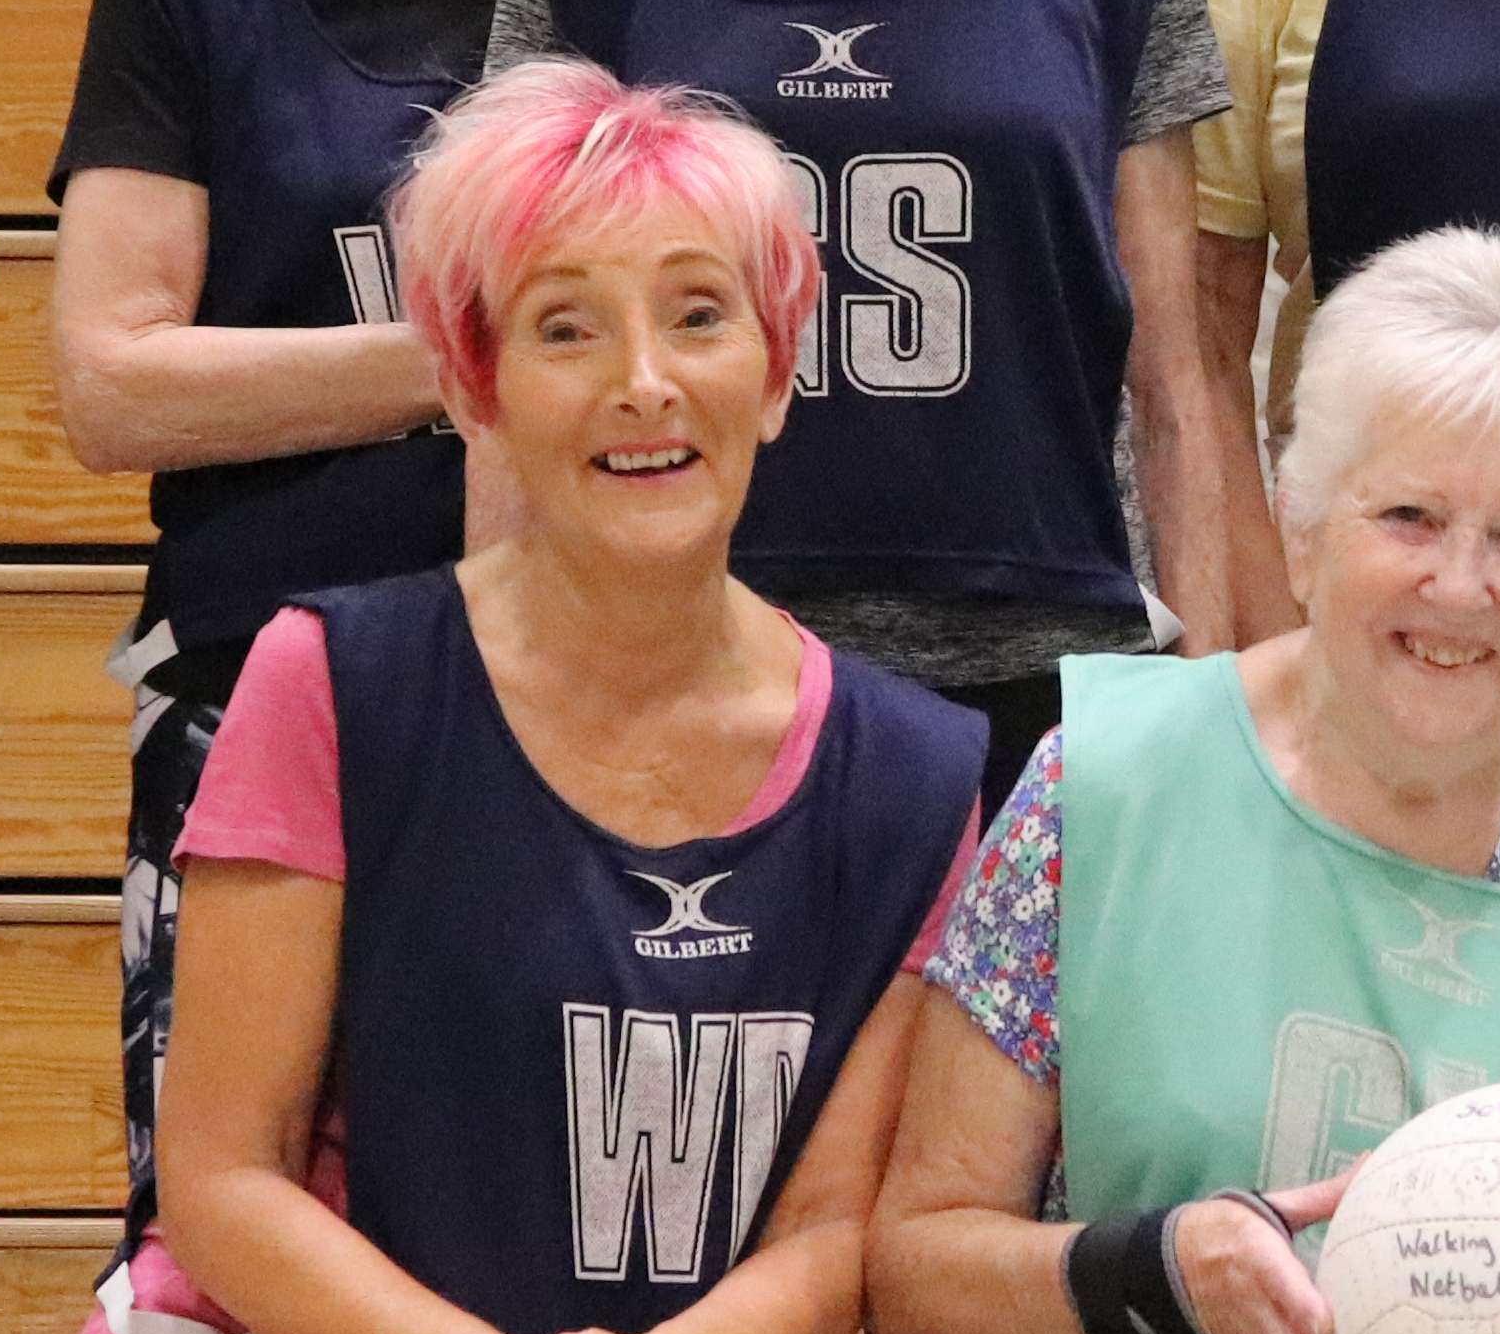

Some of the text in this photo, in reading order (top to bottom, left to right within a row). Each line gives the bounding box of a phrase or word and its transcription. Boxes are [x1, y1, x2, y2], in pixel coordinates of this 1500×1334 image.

[777, 80, 892, 99] GILBERT
[634, 932, 754, 959] GILBERT
[1257, 1012, 1490, 1197] G
[1396, 1228, 1496, 1267] Walking
